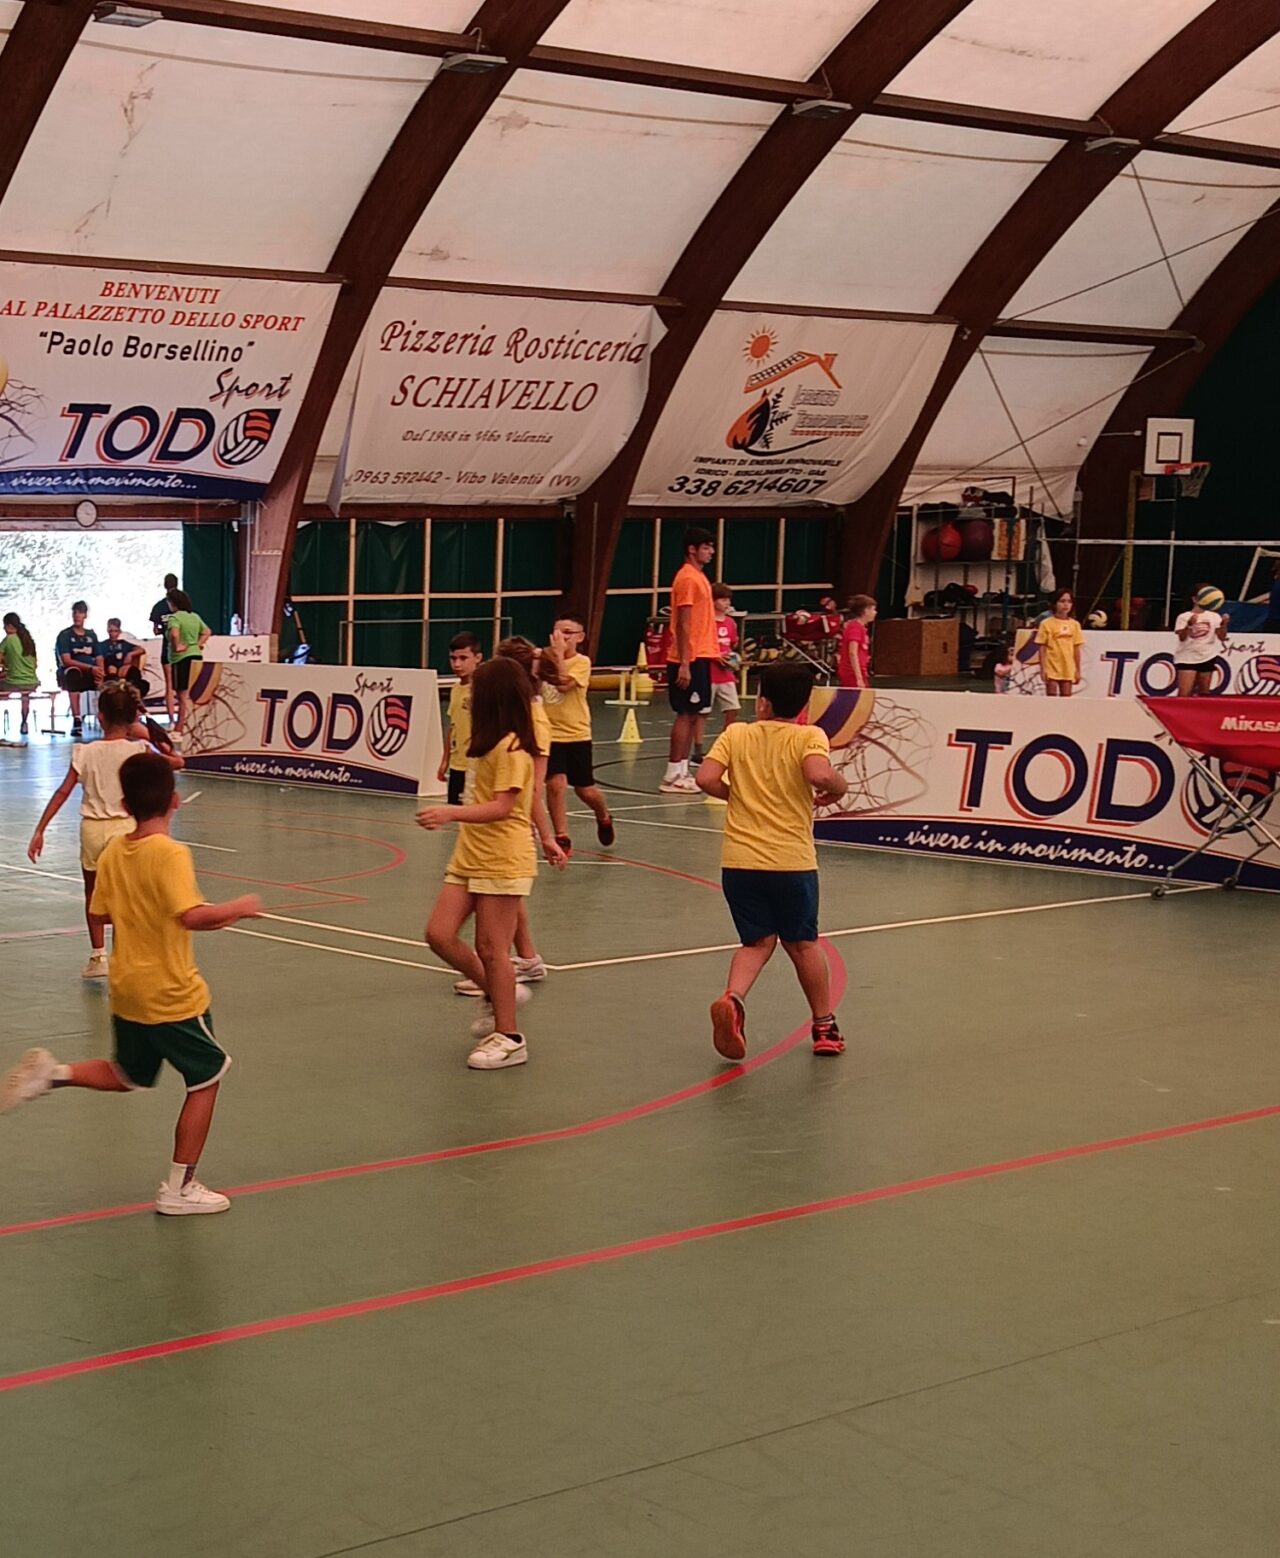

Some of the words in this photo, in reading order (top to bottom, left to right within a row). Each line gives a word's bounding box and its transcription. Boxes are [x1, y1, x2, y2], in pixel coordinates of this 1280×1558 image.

[99, 281, 220, 304] BENVENUTI
[32, 301, 165, 325] PALAZZETTO
[169, 310, 236, 328] DELLO
[239, 314, 305, 332] SPORT
[380, 320, 497, 357] Pizzeria
[504, 327, 649, 364] Rosticceria
[209, 368, 293, 406] Sport
[390, 374, 599, 412] SCHIAVELLO
[10, 472, 61, 487] vivere
[63, 472, 85, 486] in
[456, 470, 486, 484] Vibo
[491, 471, 545, 485] Valentia
[667, 476, 722, 497] 338
[723, 477, 828, 496] 6214607
[229, 643, 262, 660] Sport
[354, 672, 393, 697] Sport
[905, 824, 973, 850] vivere
[976, 830, 1005, 853] in
